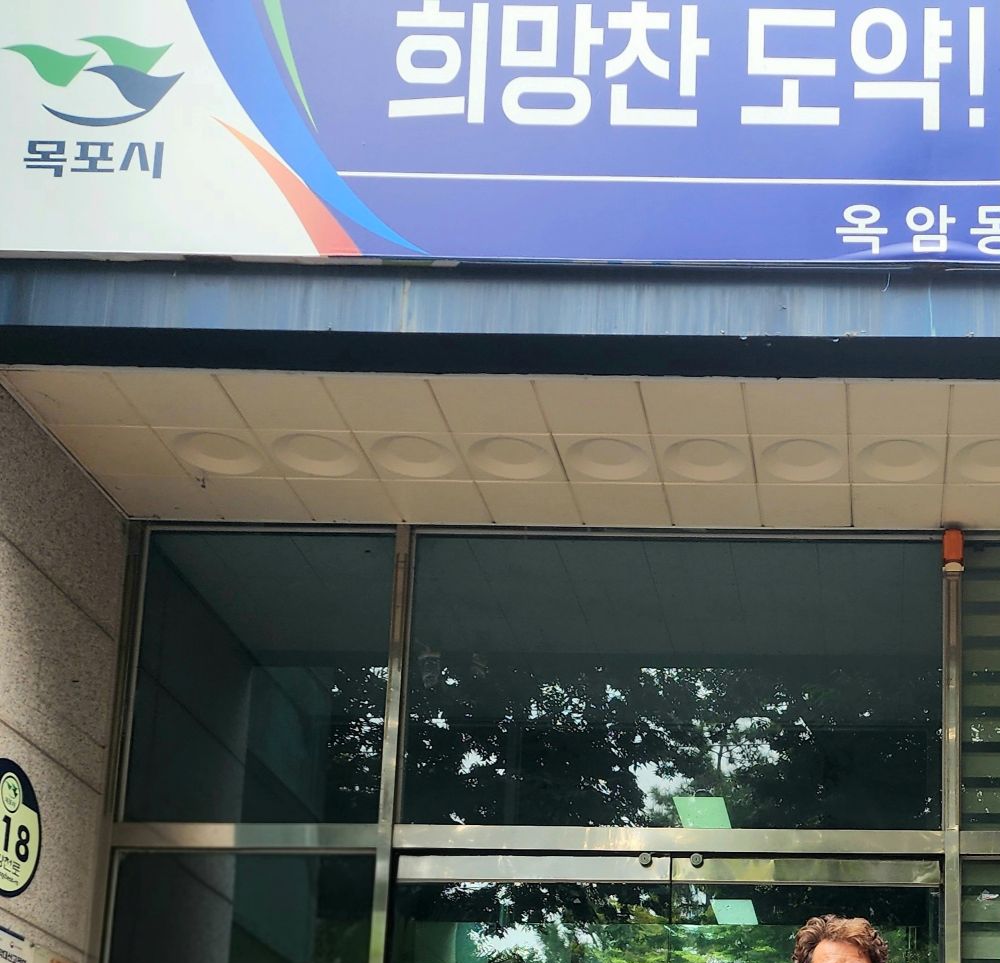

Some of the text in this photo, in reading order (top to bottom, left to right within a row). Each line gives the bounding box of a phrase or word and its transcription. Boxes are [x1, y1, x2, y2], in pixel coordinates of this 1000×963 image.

[388, 0, 710, 127] 희망찬
[740, 6, 985, 130] 도약!
[22, 139, 165, 180] 목포시
